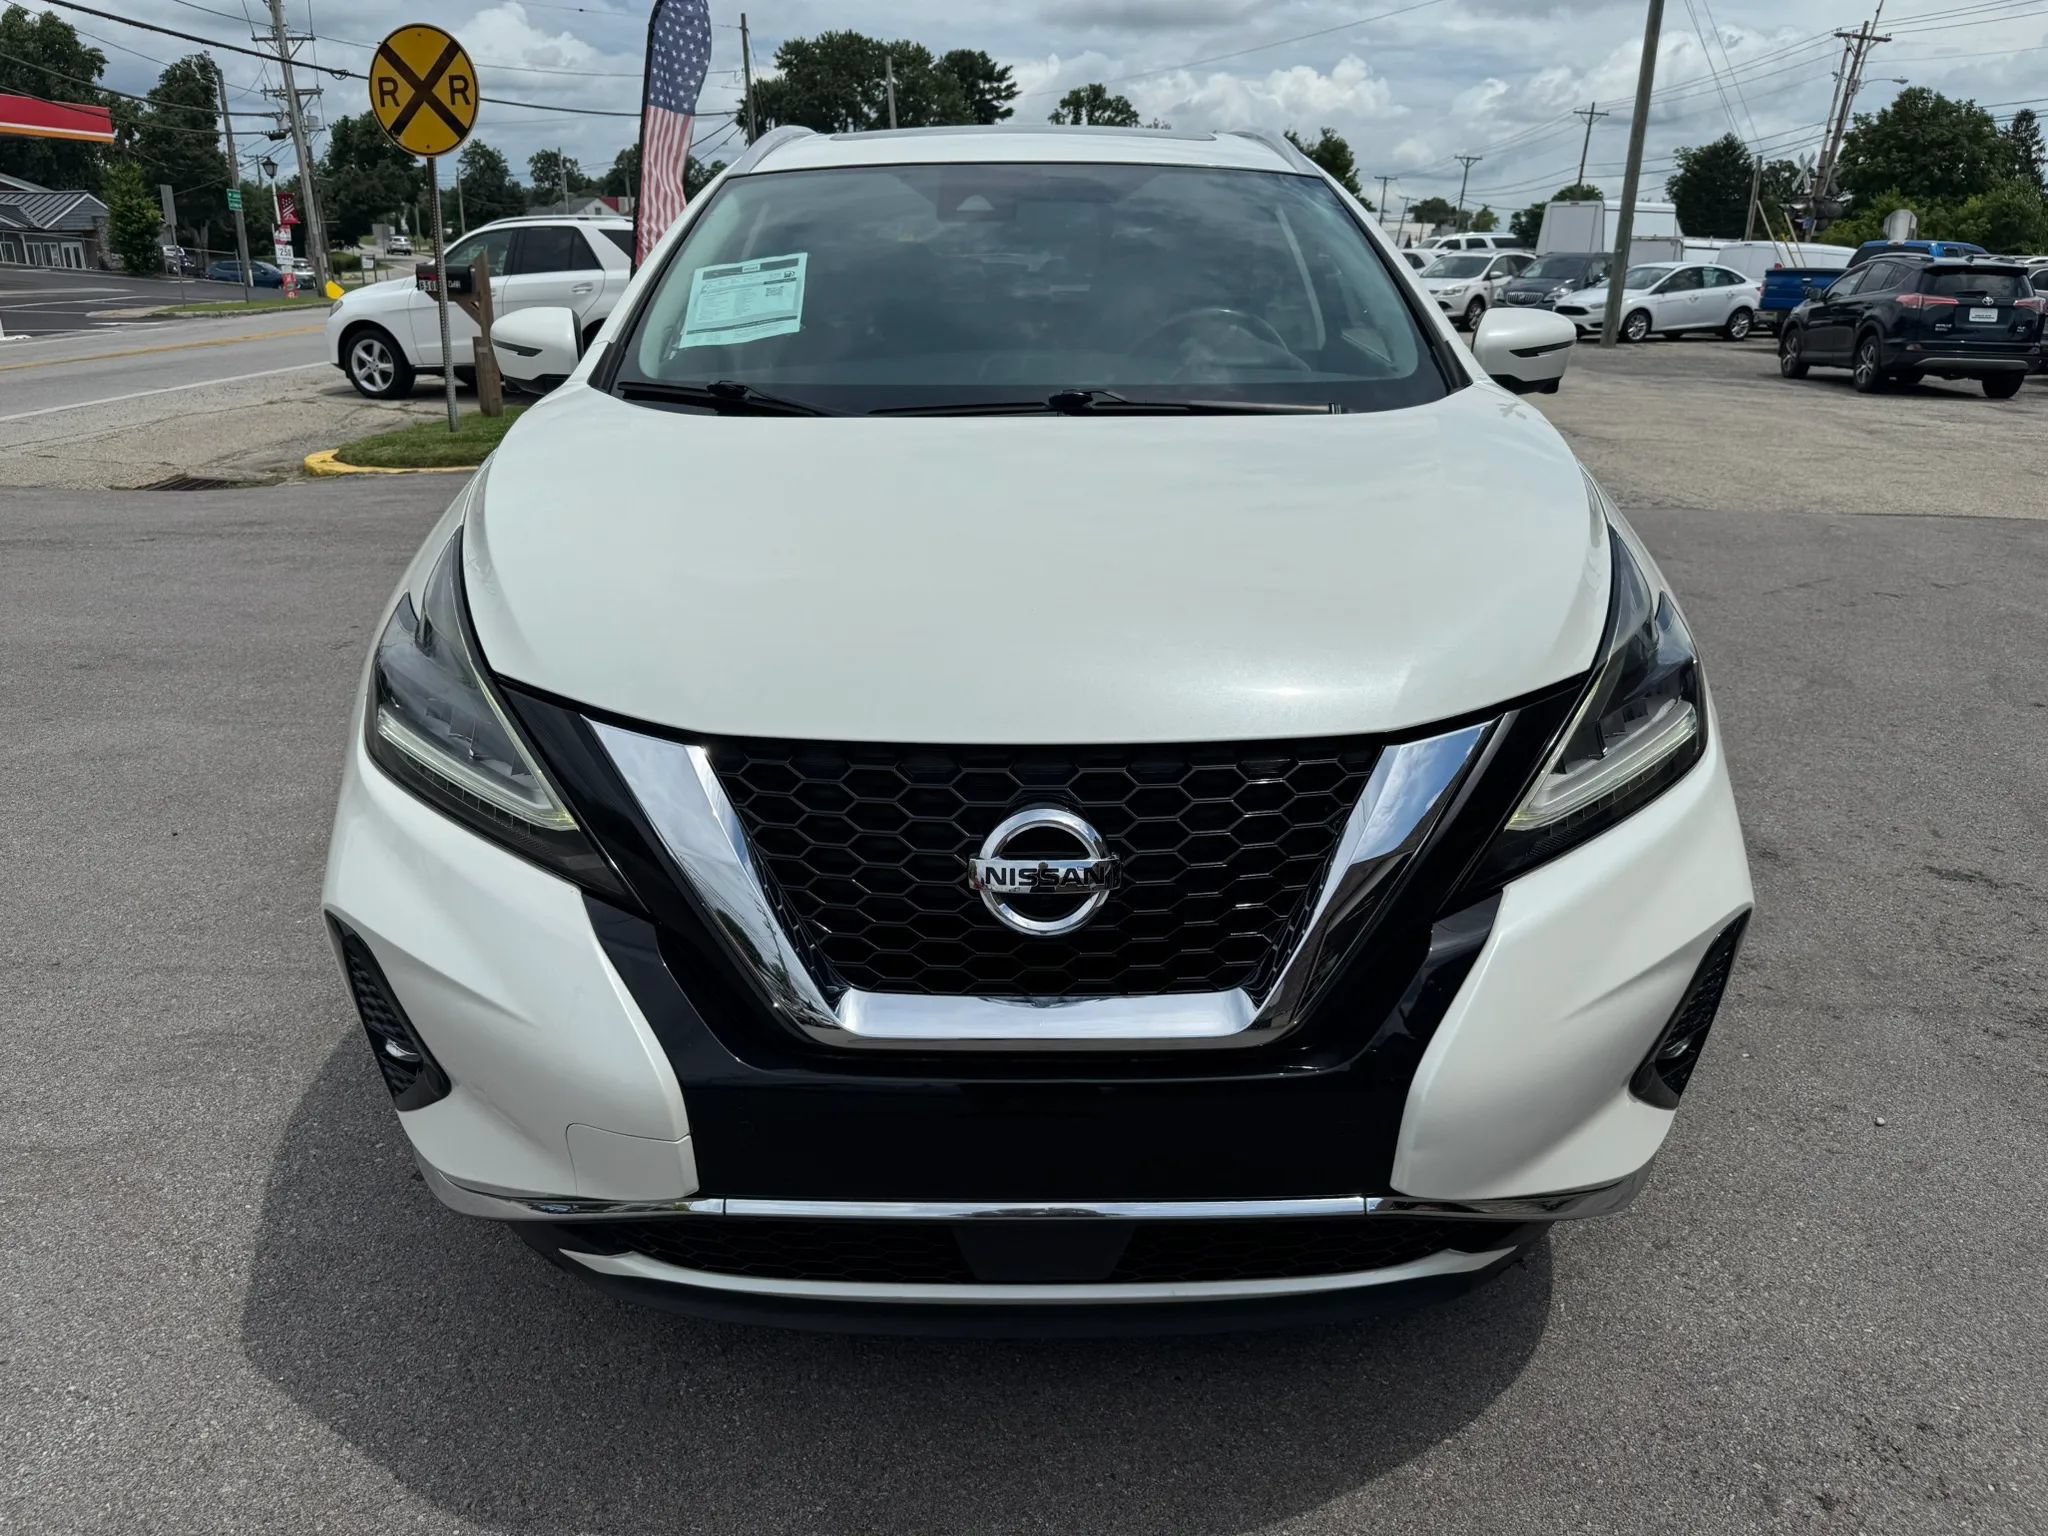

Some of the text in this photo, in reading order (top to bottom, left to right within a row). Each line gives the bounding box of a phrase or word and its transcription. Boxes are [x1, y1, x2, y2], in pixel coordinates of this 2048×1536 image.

[377, 74, 471, 108] R R
[985, 867, 1105, 886] NISSAN
